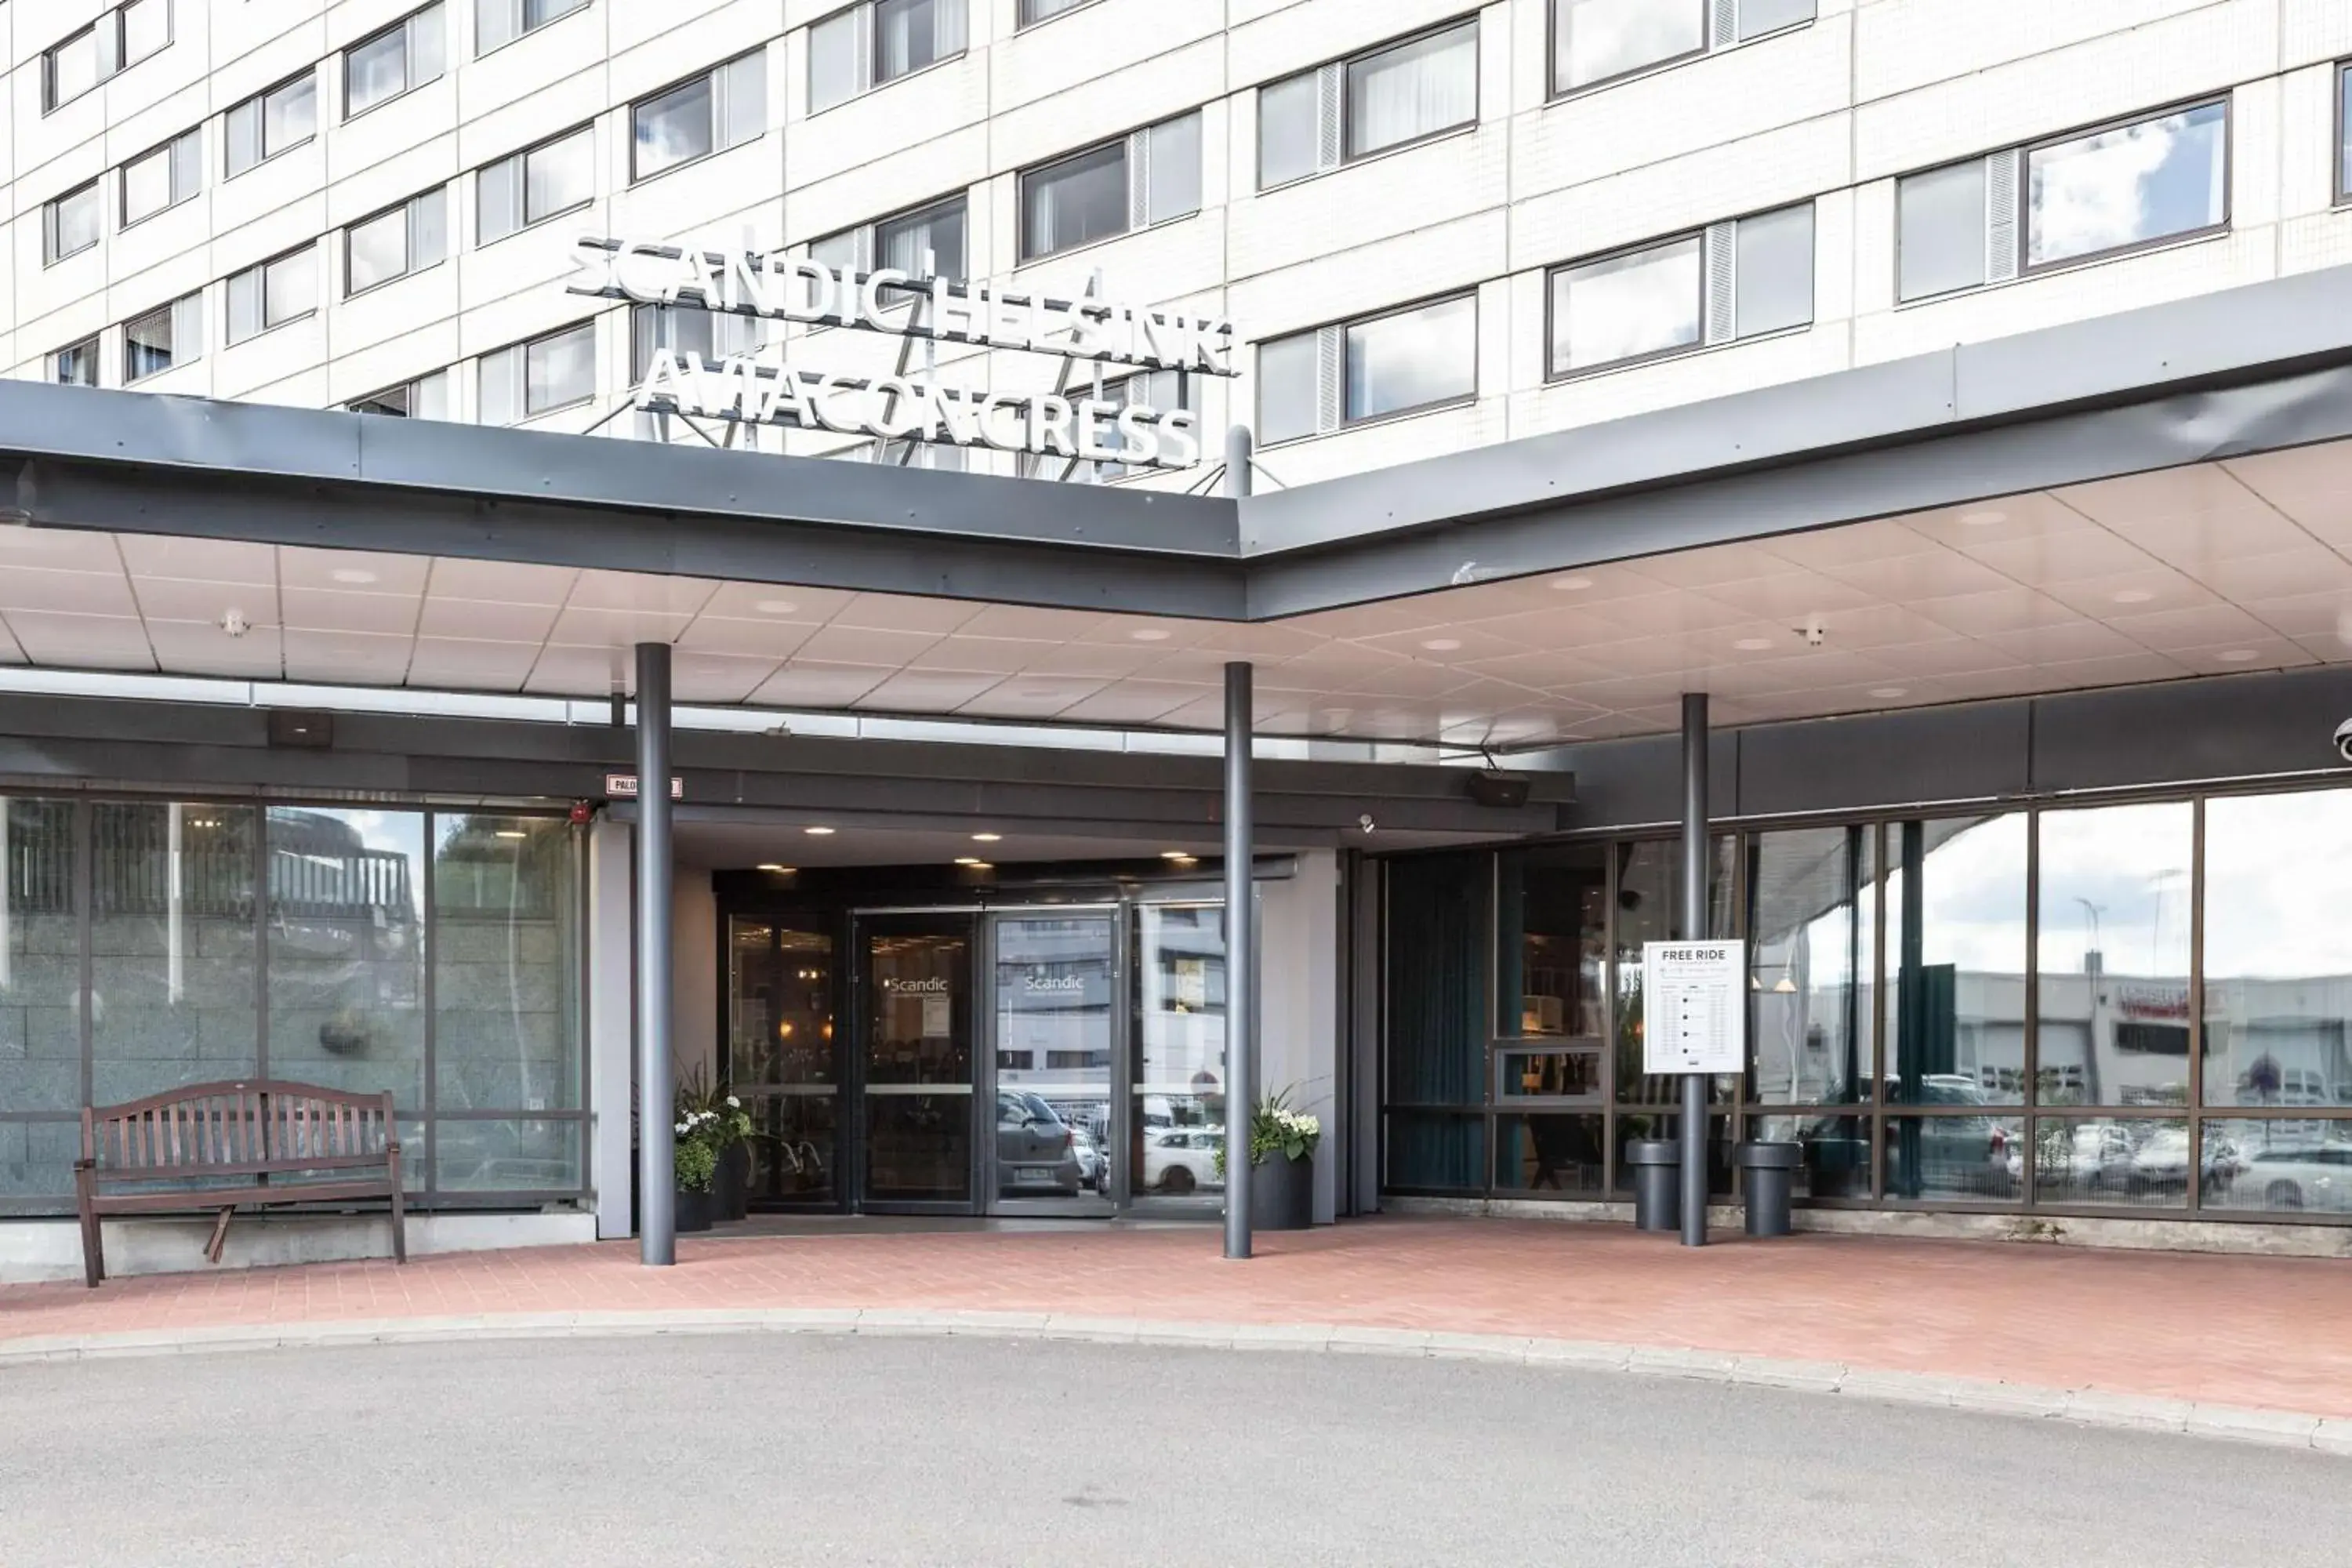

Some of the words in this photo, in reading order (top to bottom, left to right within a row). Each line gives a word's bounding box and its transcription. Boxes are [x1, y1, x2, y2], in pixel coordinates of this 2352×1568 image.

[568, 235, 909, 331] SCANDIC
[932, 276, 1242, 378] HELSINKI
[636, 347, 1197, 468] AVIACONGRESS
[1662, 950, 1693, 960] FREE
[1696, 949, 1726, 960] RIDE
[891, 977, 948, 992] Scandic
[1025, 975, 1083, 989] Scandic
